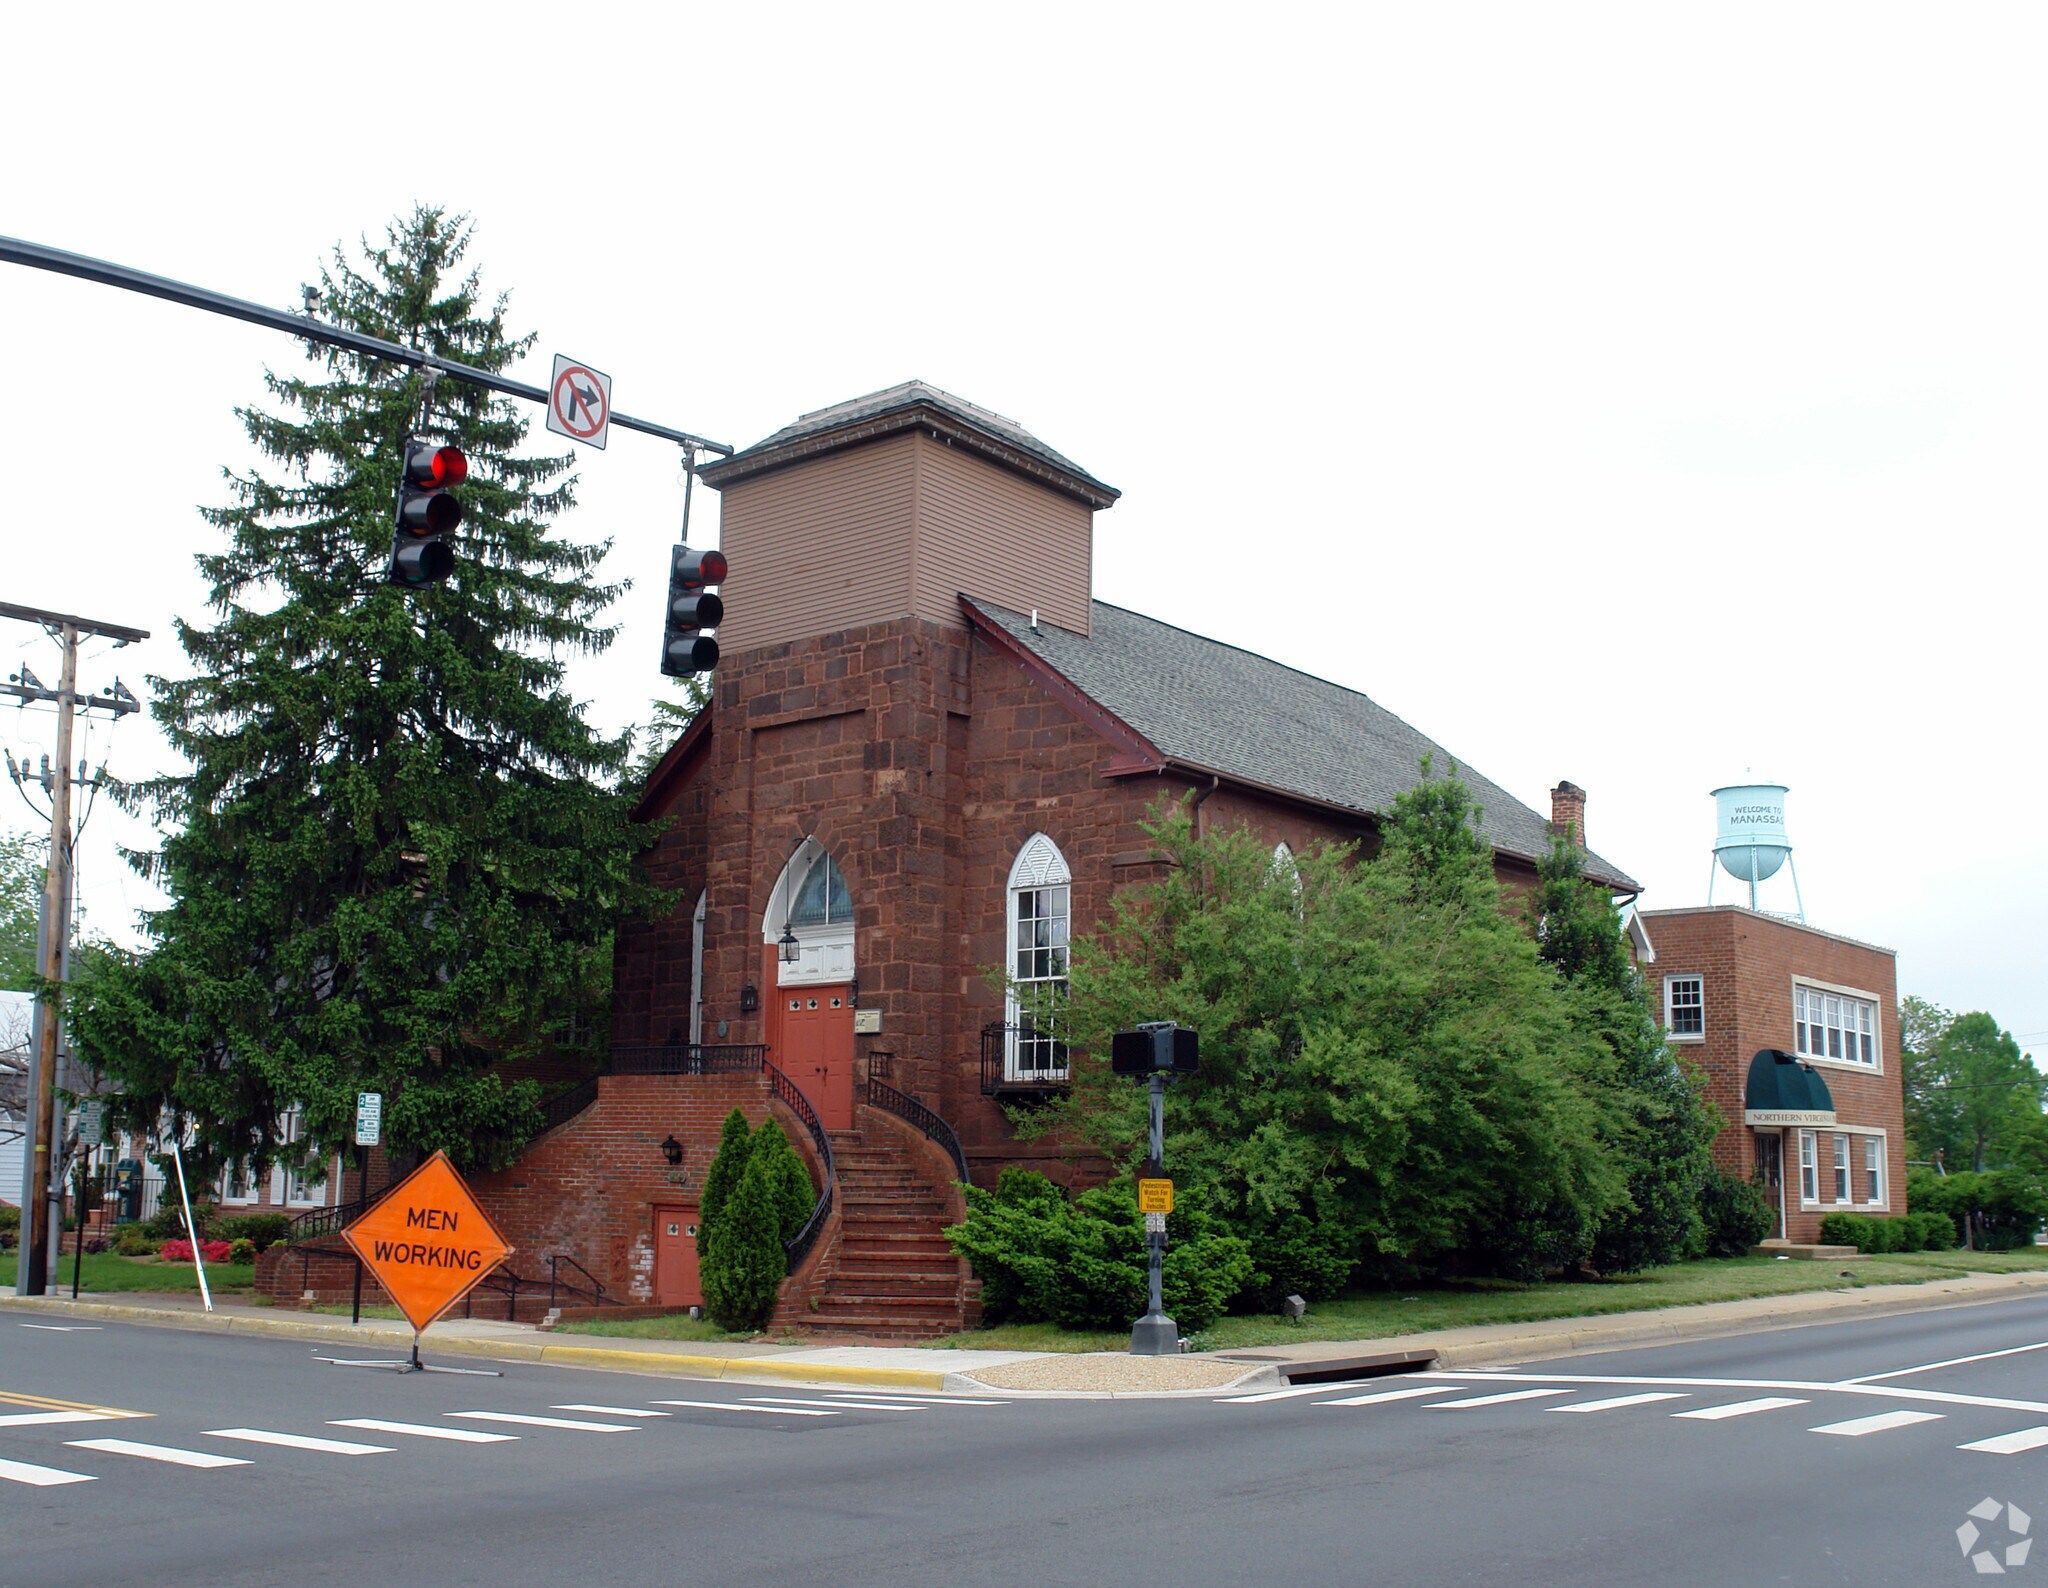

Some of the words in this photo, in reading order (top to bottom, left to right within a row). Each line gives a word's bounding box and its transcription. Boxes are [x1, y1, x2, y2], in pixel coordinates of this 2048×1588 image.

[1734, 806, 1771, 814] WELCOME
[1731, 815, 1784, 825] MANASSAS
[1753, 1113, 1802, 1122] NORTHERN
[407, 1207, 458, 1232] MEN
[374, 1240, 481, 1270] WORKING
